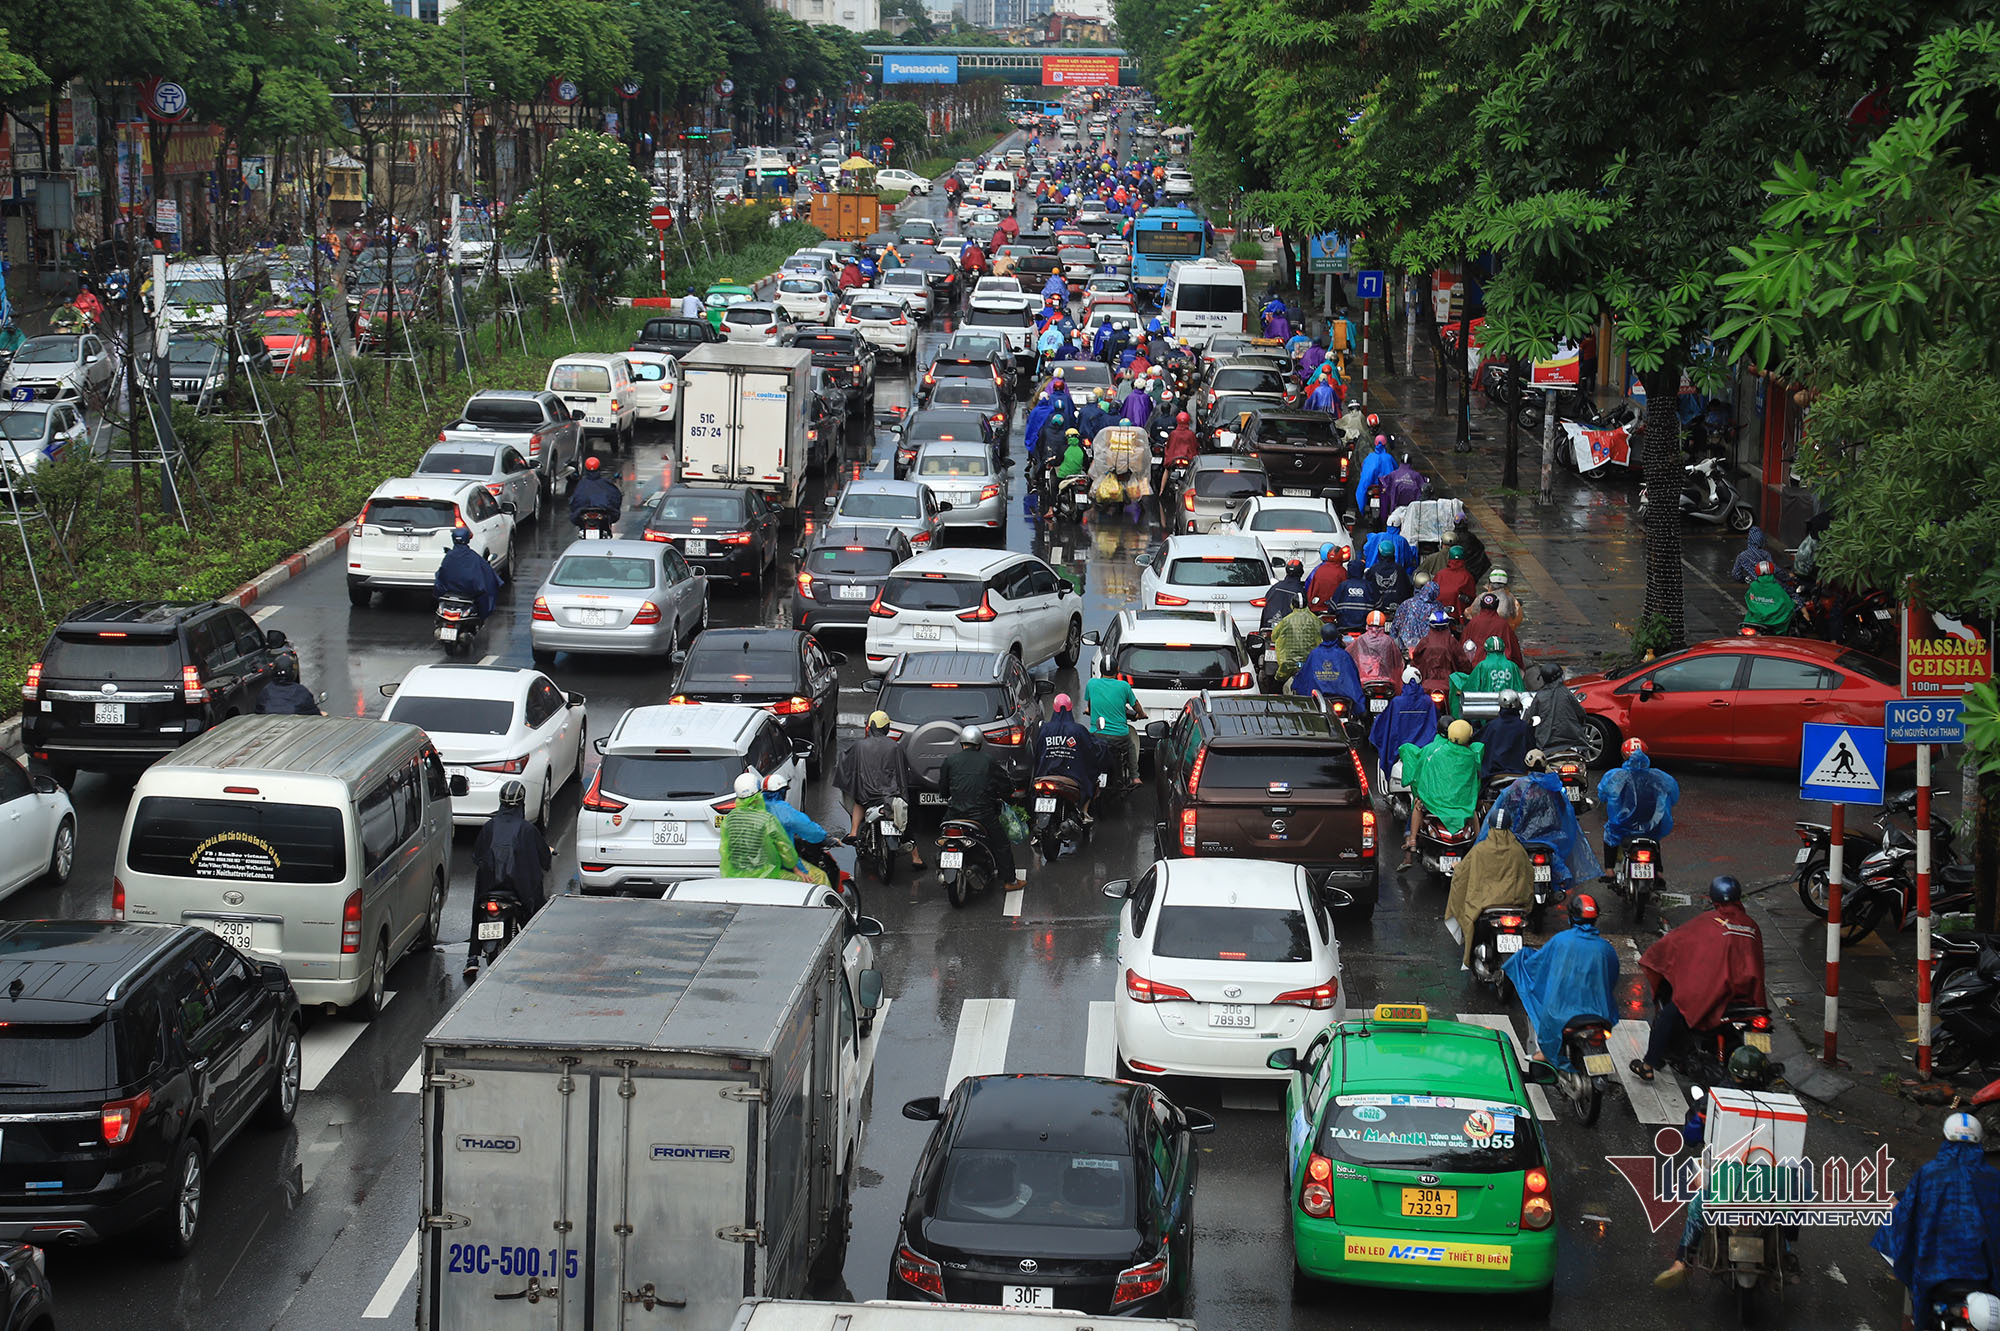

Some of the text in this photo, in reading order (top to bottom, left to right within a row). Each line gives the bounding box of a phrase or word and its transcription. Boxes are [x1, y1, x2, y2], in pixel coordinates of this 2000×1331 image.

[891, 64, 949, 74] Panasonic
[700, 413, 716, 425] 51C
[1909, 639, 1986, 656] MASSAGE
[1909, 659, 1985, 676] GEISHA
[1912, 681, 1939, 692] 100m
[102, 704, 119, 713] 30E
[1894, 705, 1955, 723] NGÕ 97
[95, 713, 124, 723] 659.61
[1940, 727, 1960, 737] THANH
[661, 822, 679, 833] 30G
[654, 832, 686, 844] 367.04
[223, 923, 243, 935] 29D
[1222, 1003, 1242, 1014] 30G
[1391, 1009, 1422, 1019] 1055
[1214, 1013, 1252, 1026] 789.99
[462, 1138, 516, 1150] THACO
[1471, 1134, 1514, 1149] 1055
[654, 1147, 731, 1160] FRONTIER
[1336, 1165, 1356, 1174] New
[1336, 1173, 1369, 1182] morning
[1418, 1190, 1441, 1202] 30A
[1407, 1203, 1452, 1216] 732.97
[1348, 1243, 1365, 1256] ĐÈN
[1367, 1246, 1385, 1257] LED
[1387, 1245, 1446, 1262] MPE
[1448, 1249, 1473, 1263] THIẾT
[1476, 1252, 1486, 1265] BỊ
[448, 1243, 579, 1280] 29C-500.15
[942, 1260, 968, 1270] VIOS
[1014, 1288, 1042, 1304] 30F
